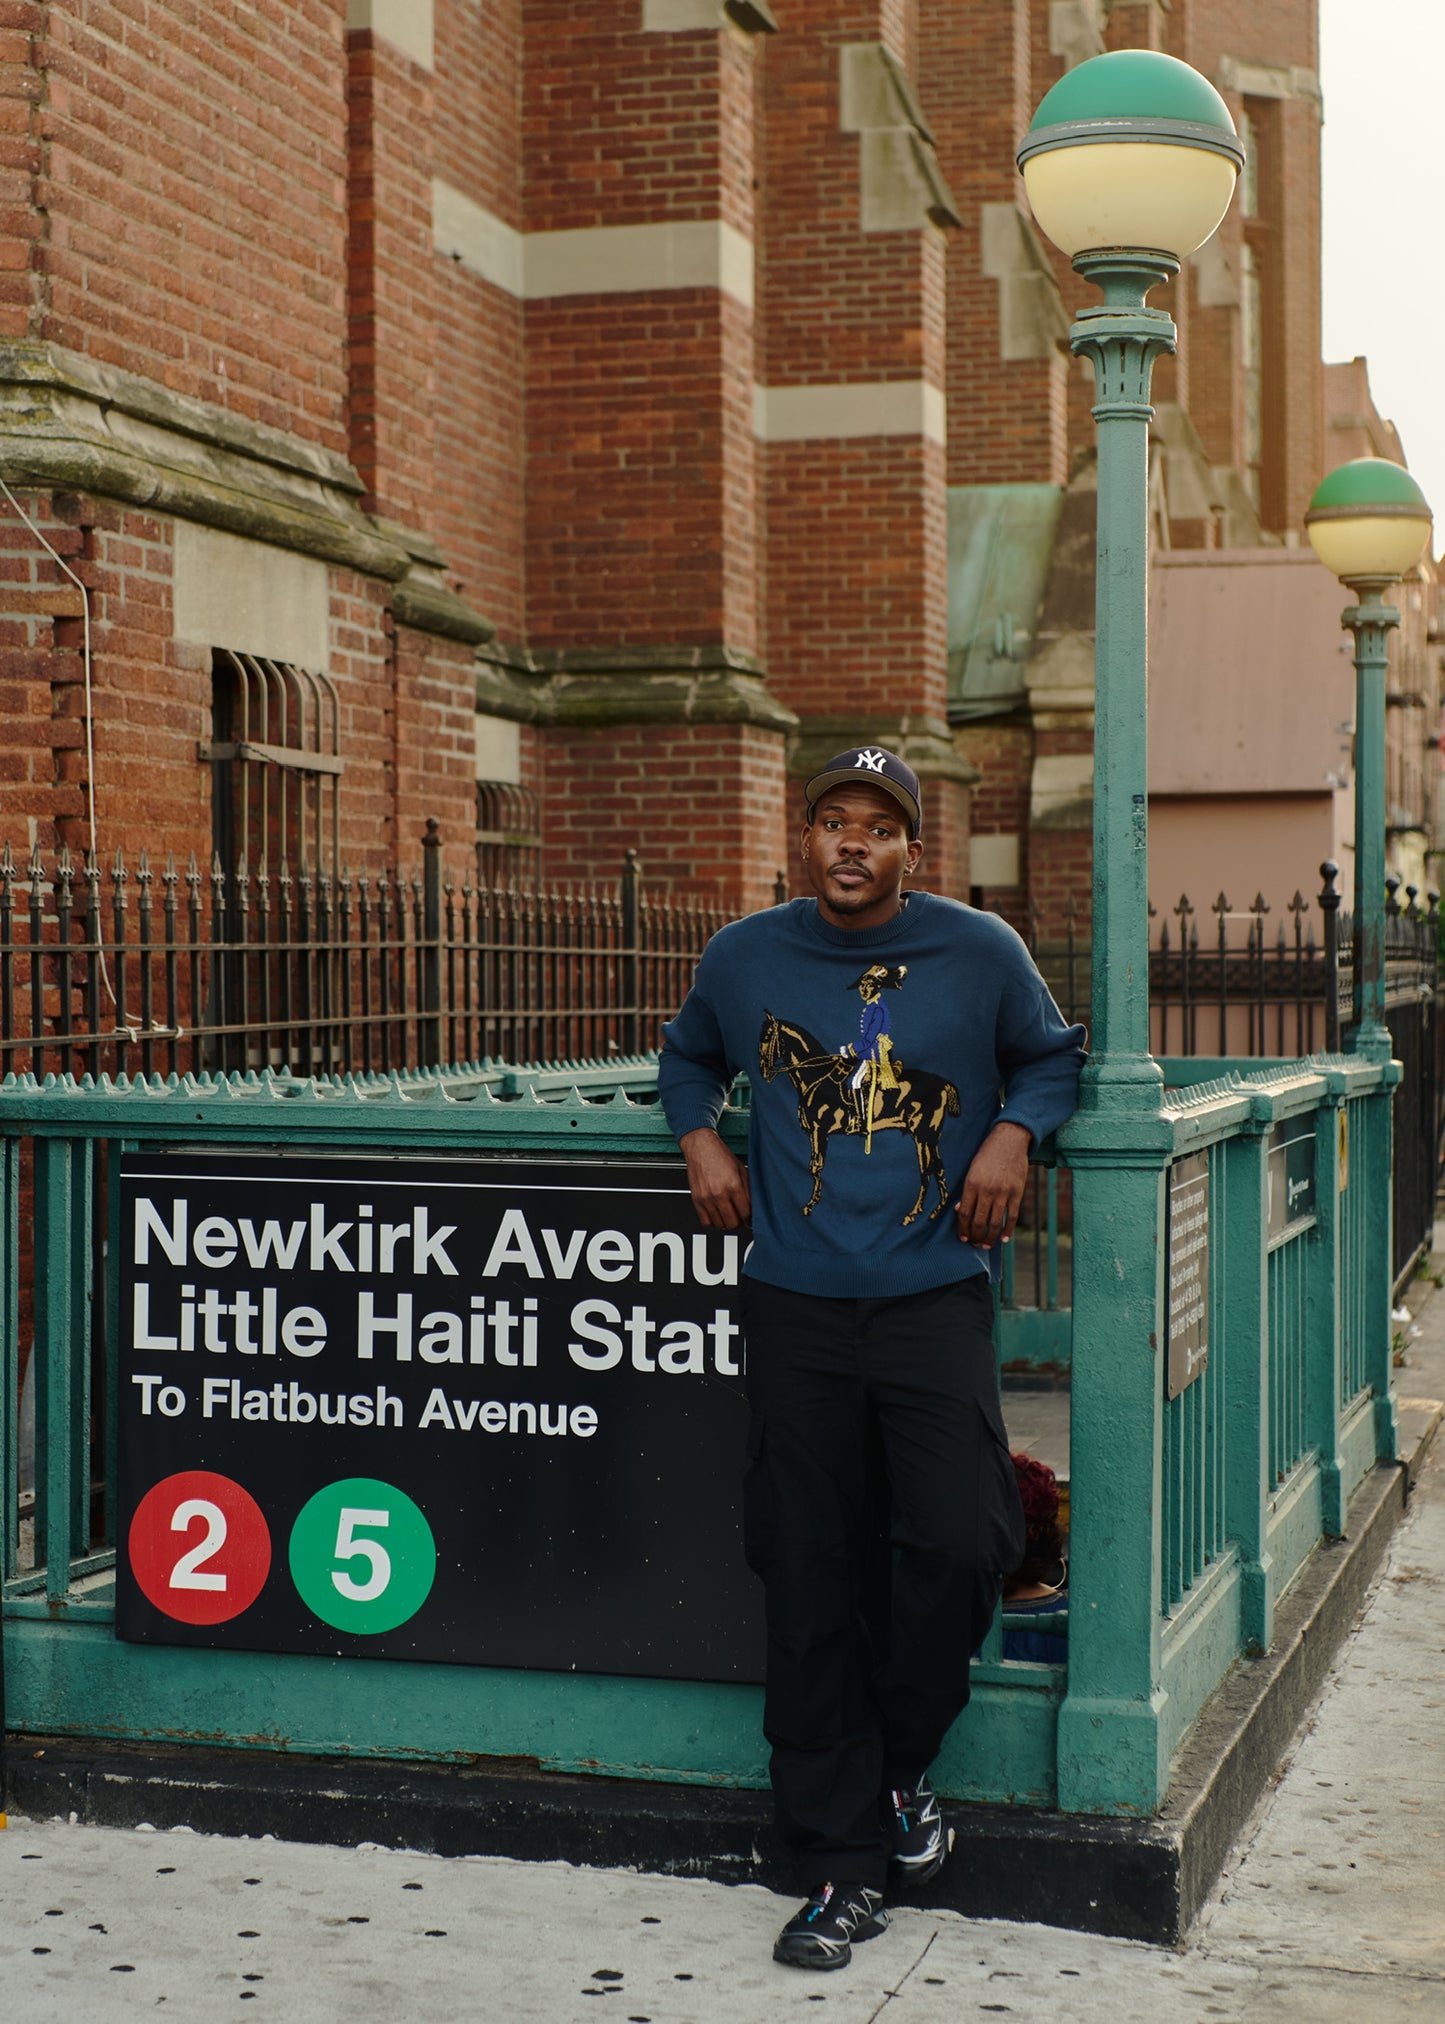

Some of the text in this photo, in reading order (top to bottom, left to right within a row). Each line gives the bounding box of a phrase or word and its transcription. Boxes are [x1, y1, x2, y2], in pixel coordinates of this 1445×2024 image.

[854, 749, 887, 773] NY
[134, 1197, 755, 1287] Newkirk Avenu
[132, 1282, 747, 1376] Little Haiti Stat
[131, 1374, 599, 1438] To Flatbush Avenue
[168, 1498, 392, 1602] 2 5
